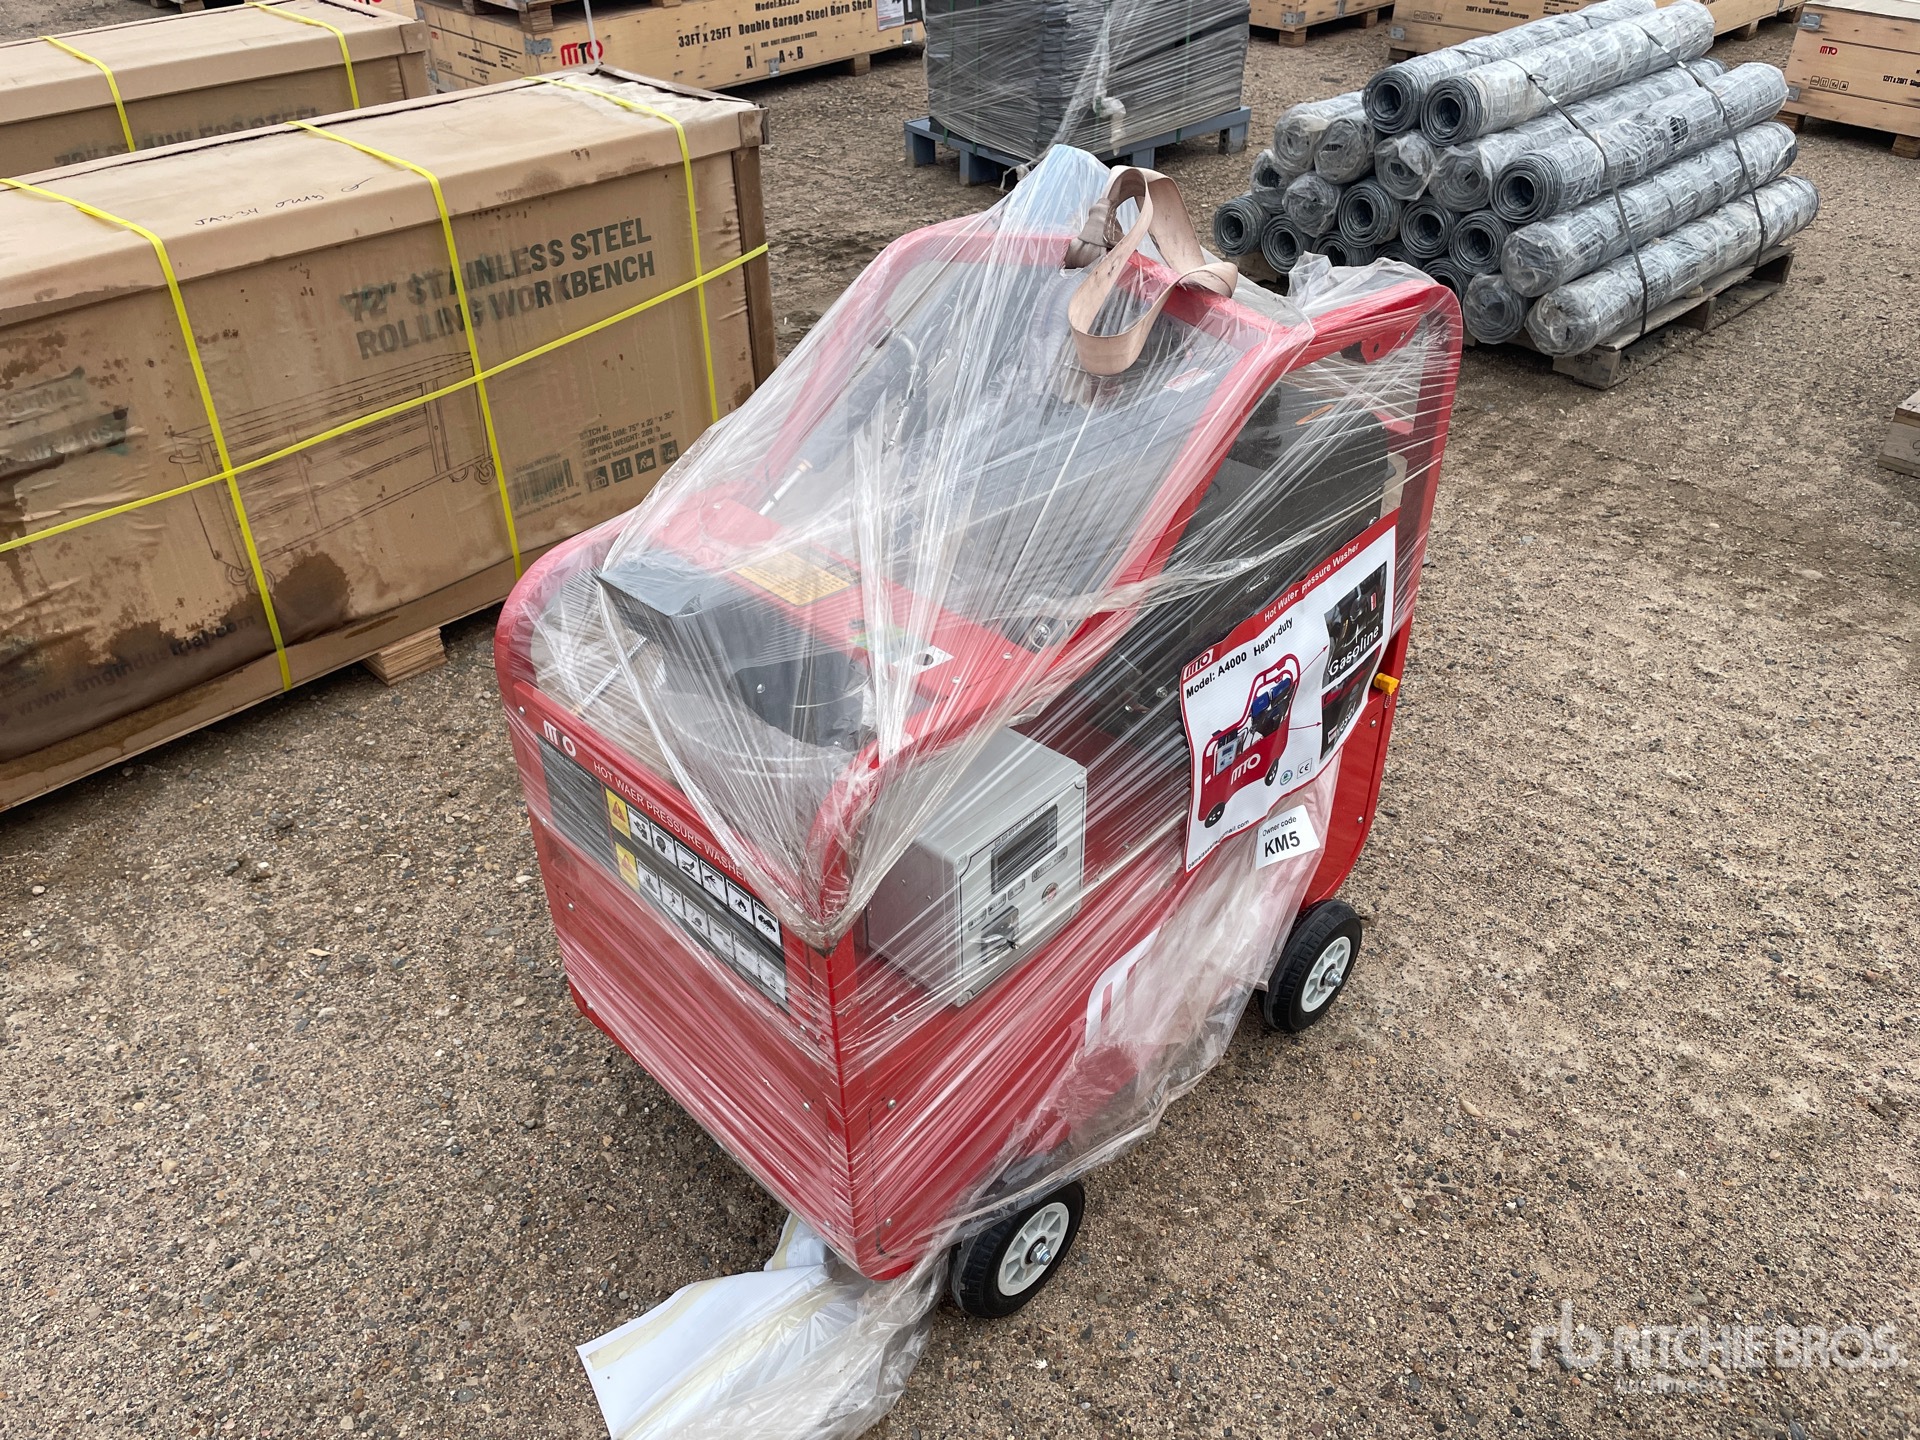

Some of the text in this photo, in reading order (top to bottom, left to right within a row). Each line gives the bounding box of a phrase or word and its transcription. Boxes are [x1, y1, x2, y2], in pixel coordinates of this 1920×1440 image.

[678, 0, 872, 48] 33FT x 25FT Double Garage Steel Barn Shed
[1495, 8, 1510, 17] Metal
[1510, 10, 1529, 19] Garage
[746, 55, 753, 70] A
[778, 49, 786, 63] A
[797, 46, 803, 59] B
[1819, 45, 1838, 56] MTO
[406, 238, 566, 305] STAINLESS
[570, 217, 652, 261] STEEL
[356, 250, 656, 361] ROLLING WORKBENCH
[614, 432, 641, 448] WEIGHT:
[1264, 608, 1277, 623] Hot
[1277, 589, 1299, 611] Water
[1332, 542, 1360, 568] Washer
[1253, 617, 1293, 657] Heavy-duty
[1328, 626, 1380, 677] Gasoline
[1186, 652, 1247, 699] Model: A4000
[593, 761, 613, 782] HOT
[615, 779, 645, 807] WAER
[646, 800, 702, 850] PRESSURE
[1262, 816, 1297, 837] Owner code
[1264, 830, 1301, 858] KM5
